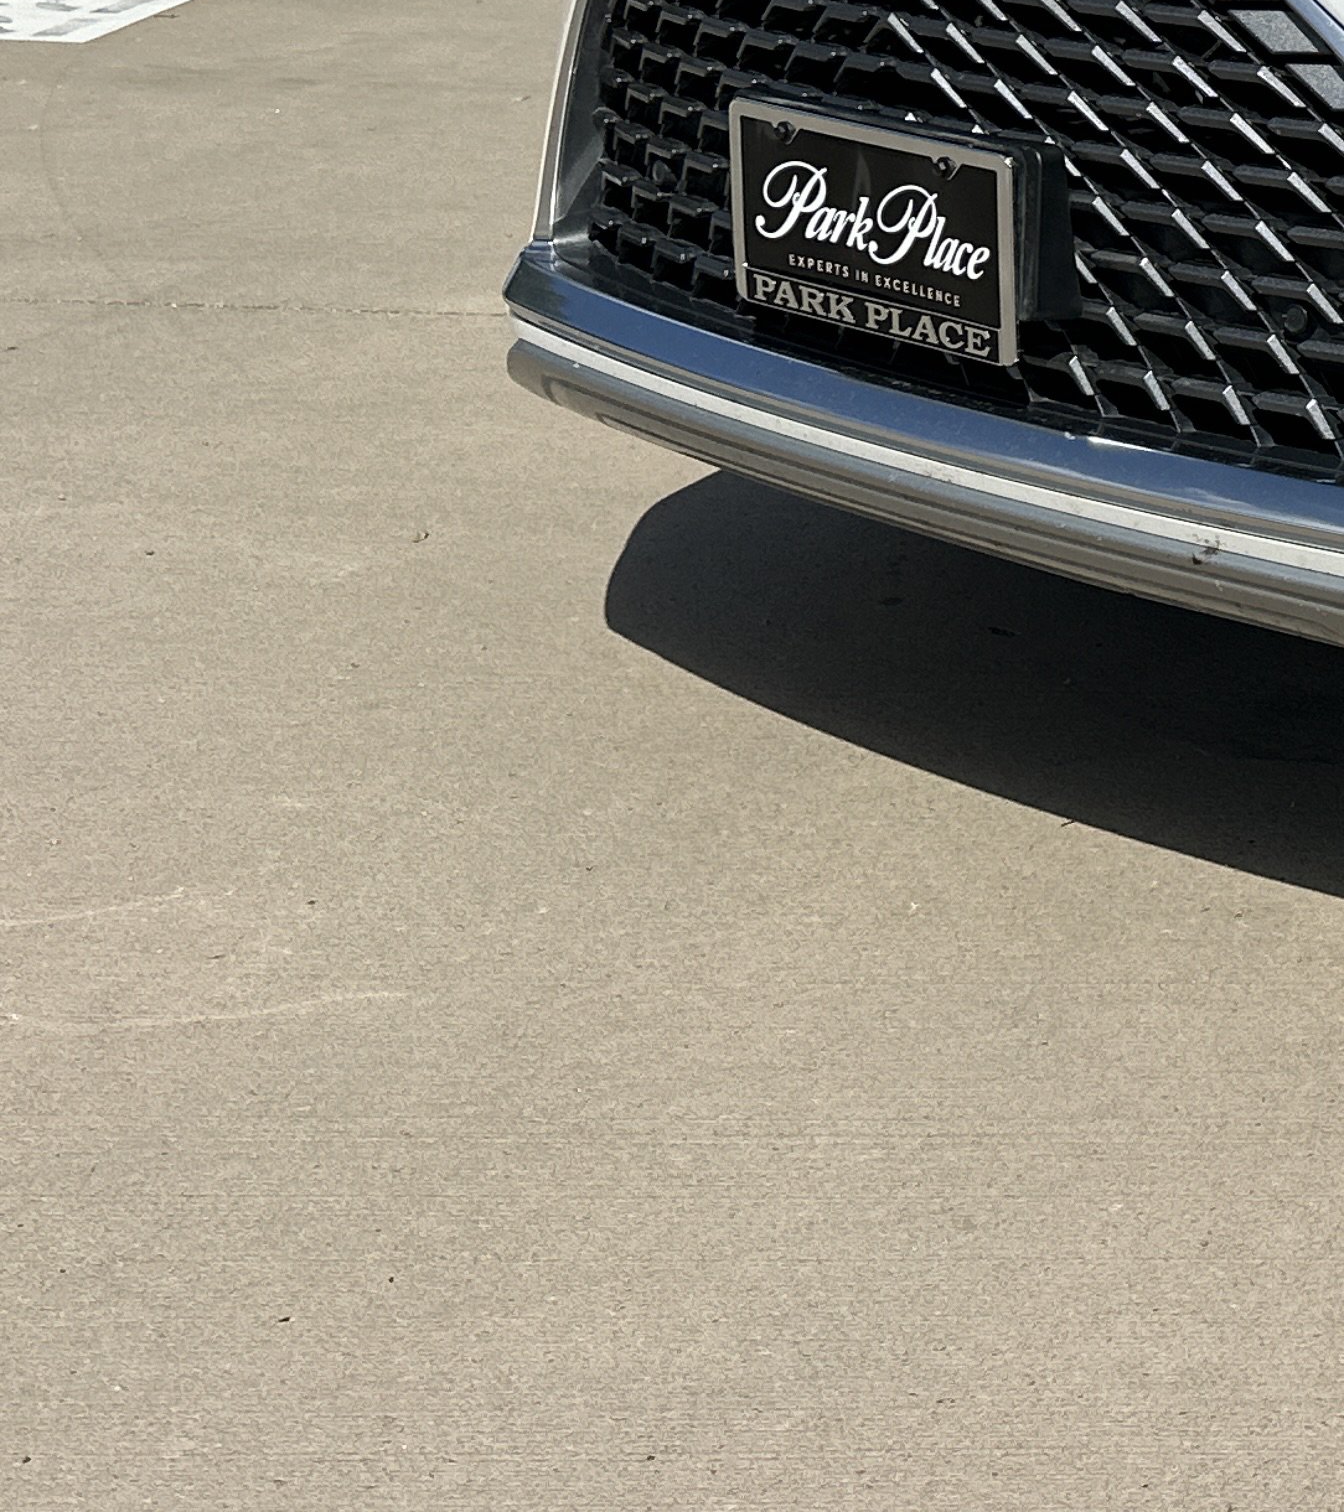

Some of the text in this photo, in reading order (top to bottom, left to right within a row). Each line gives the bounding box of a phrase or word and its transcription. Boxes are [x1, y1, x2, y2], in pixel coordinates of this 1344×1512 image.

[755, 160, 991, 280] Park Place
[753, 273, 992, 358] PARK PLACE
[788, 253, 962, 308] EXPERTS IN EXCELLENCE
